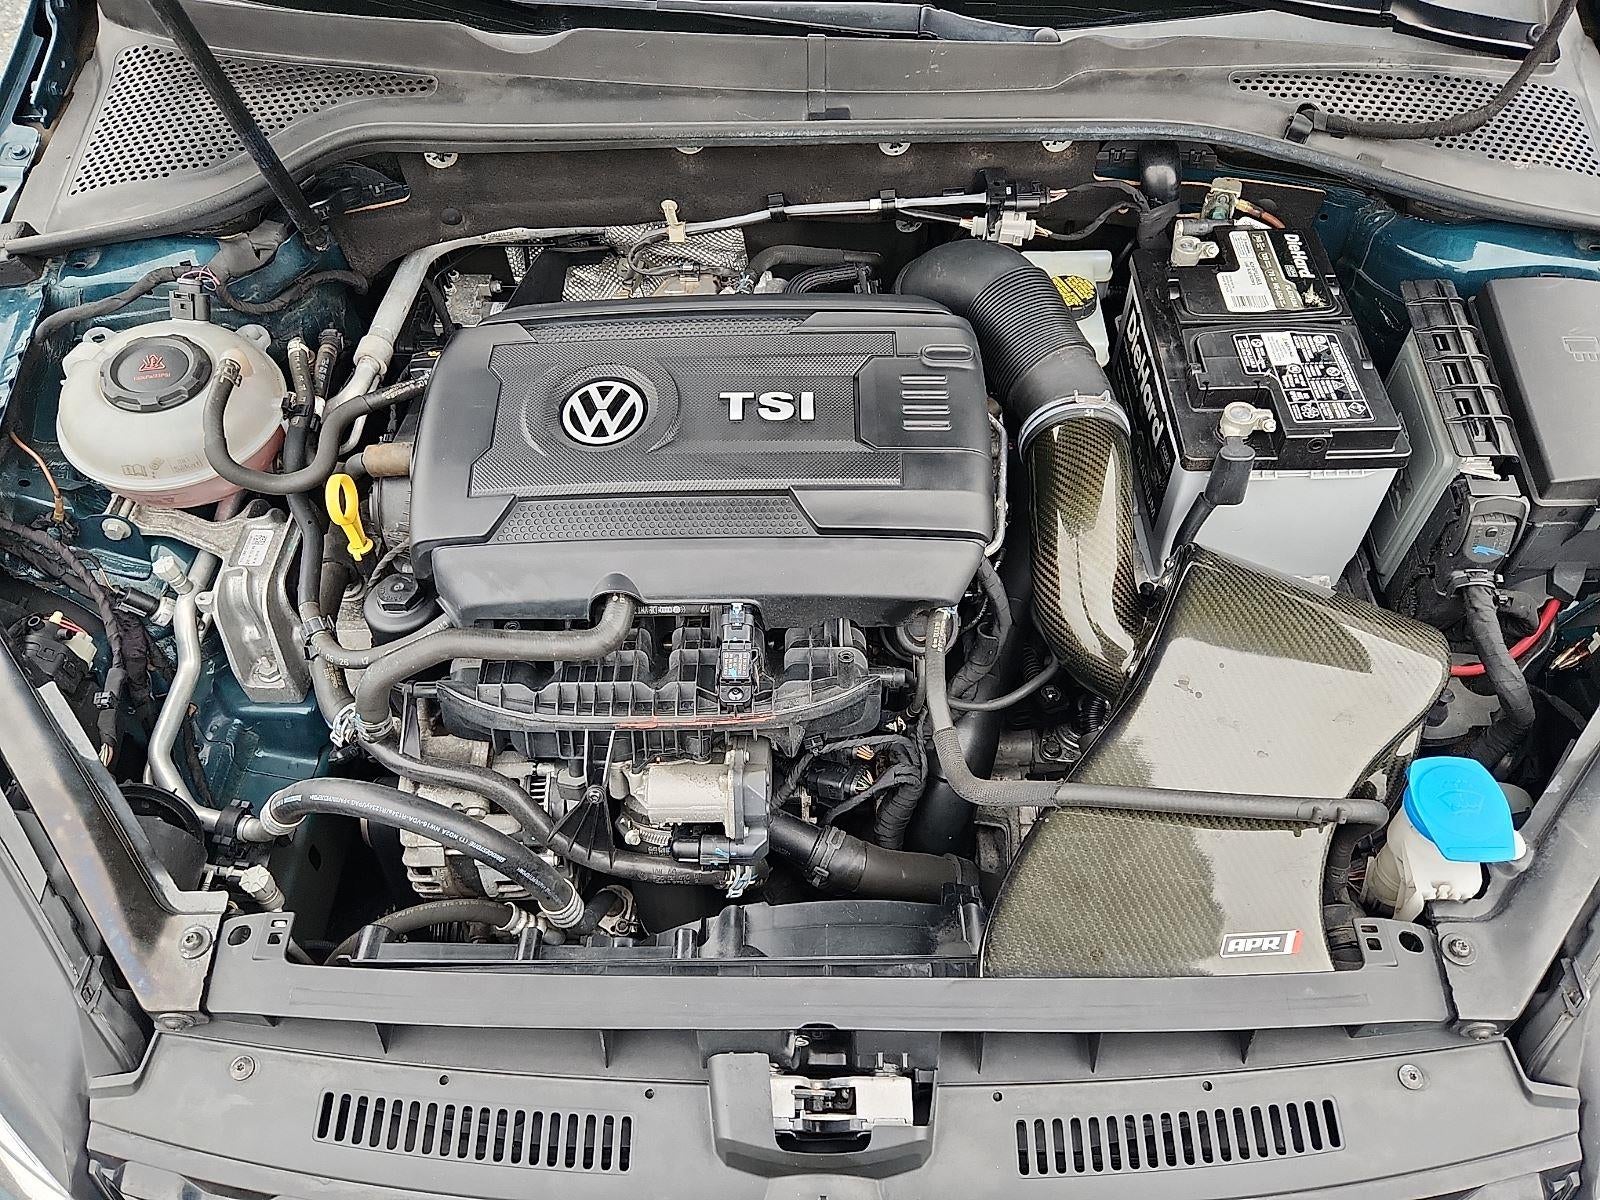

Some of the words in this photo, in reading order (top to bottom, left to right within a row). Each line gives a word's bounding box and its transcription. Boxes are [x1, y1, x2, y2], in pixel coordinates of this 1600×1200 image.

[1283, 232, 1316, 279] DieHard
[1126, 308, 1164, 448] DieHard
[719, 391, 815, 422] TSI
[1227, 936, 1281, 953] APR
